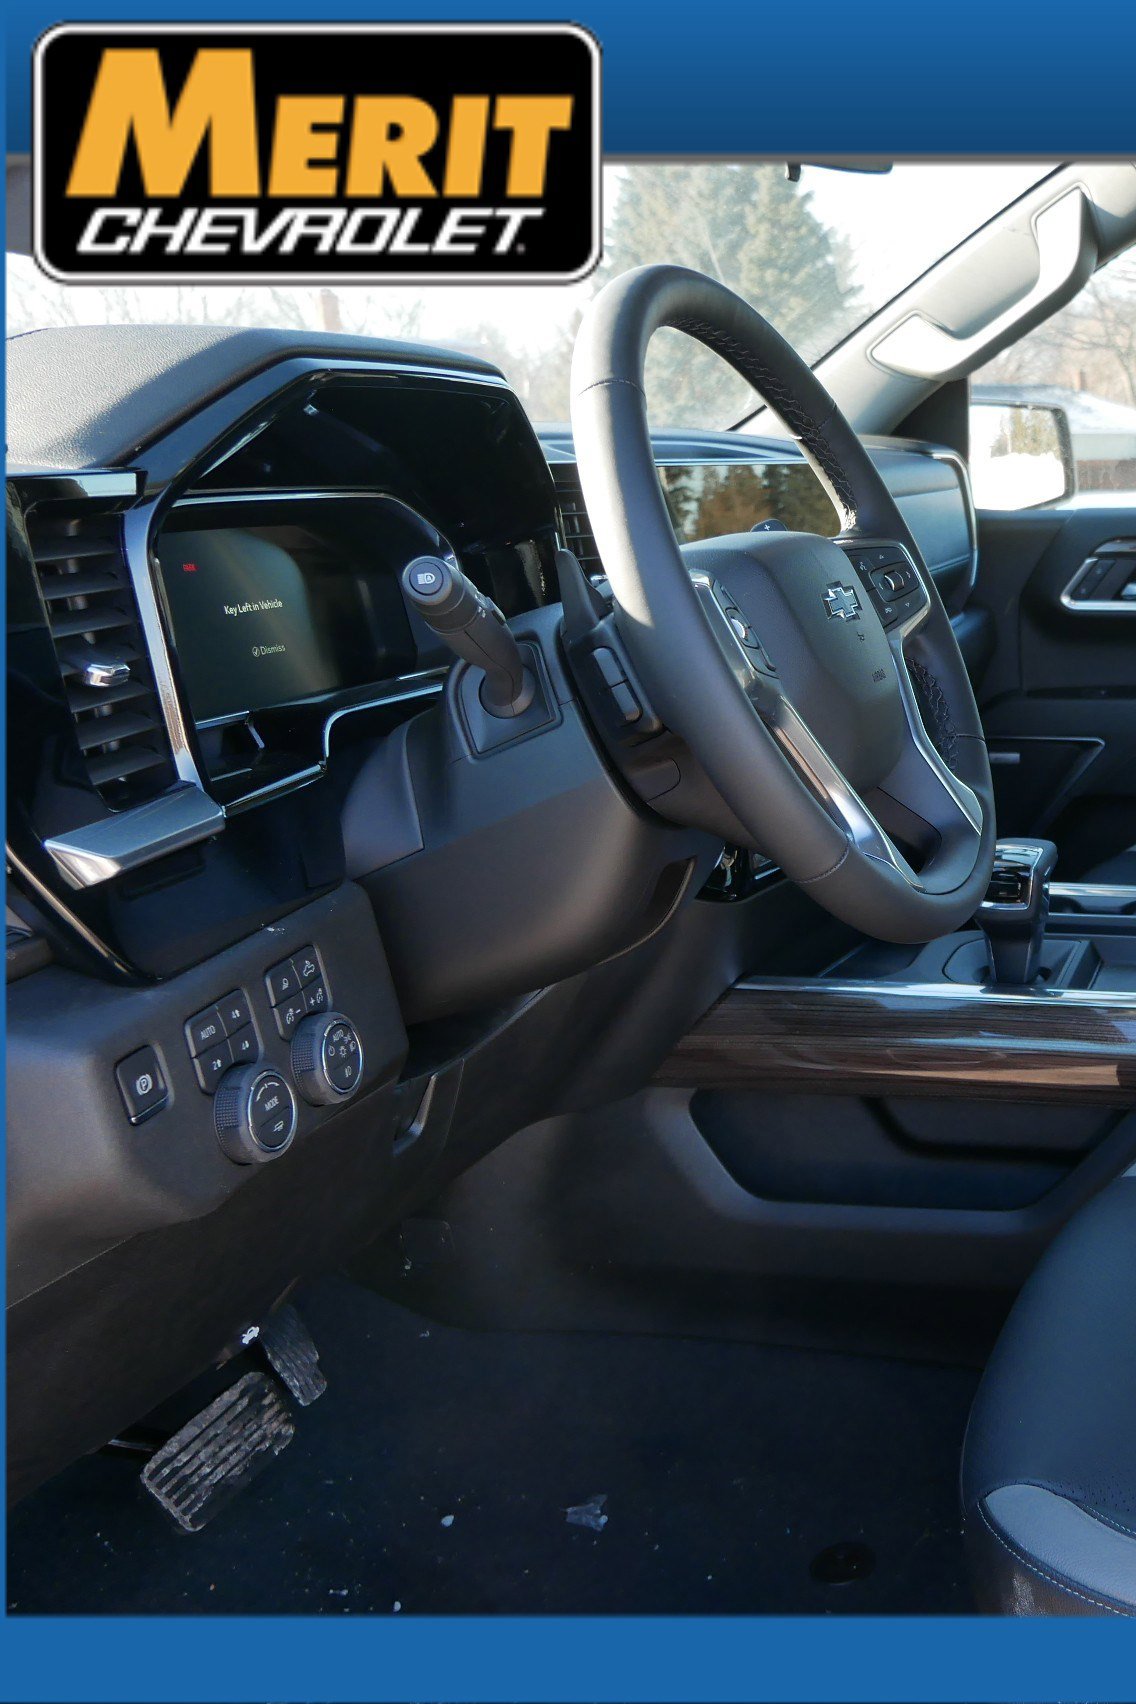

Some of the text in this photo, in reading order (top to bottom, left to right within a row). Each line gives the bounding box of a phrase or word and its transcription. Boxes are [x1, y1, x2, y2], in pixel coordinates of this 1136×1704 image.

[224, 598, 283, 616] Key Left in Vehicle
[260, 644, 286, 655] Dismiss
[200, 1025, 216, 1040] AUTO
[332, 1029, 345, 1042] AUTO
[264, 1096, 279, 1111] MODE
